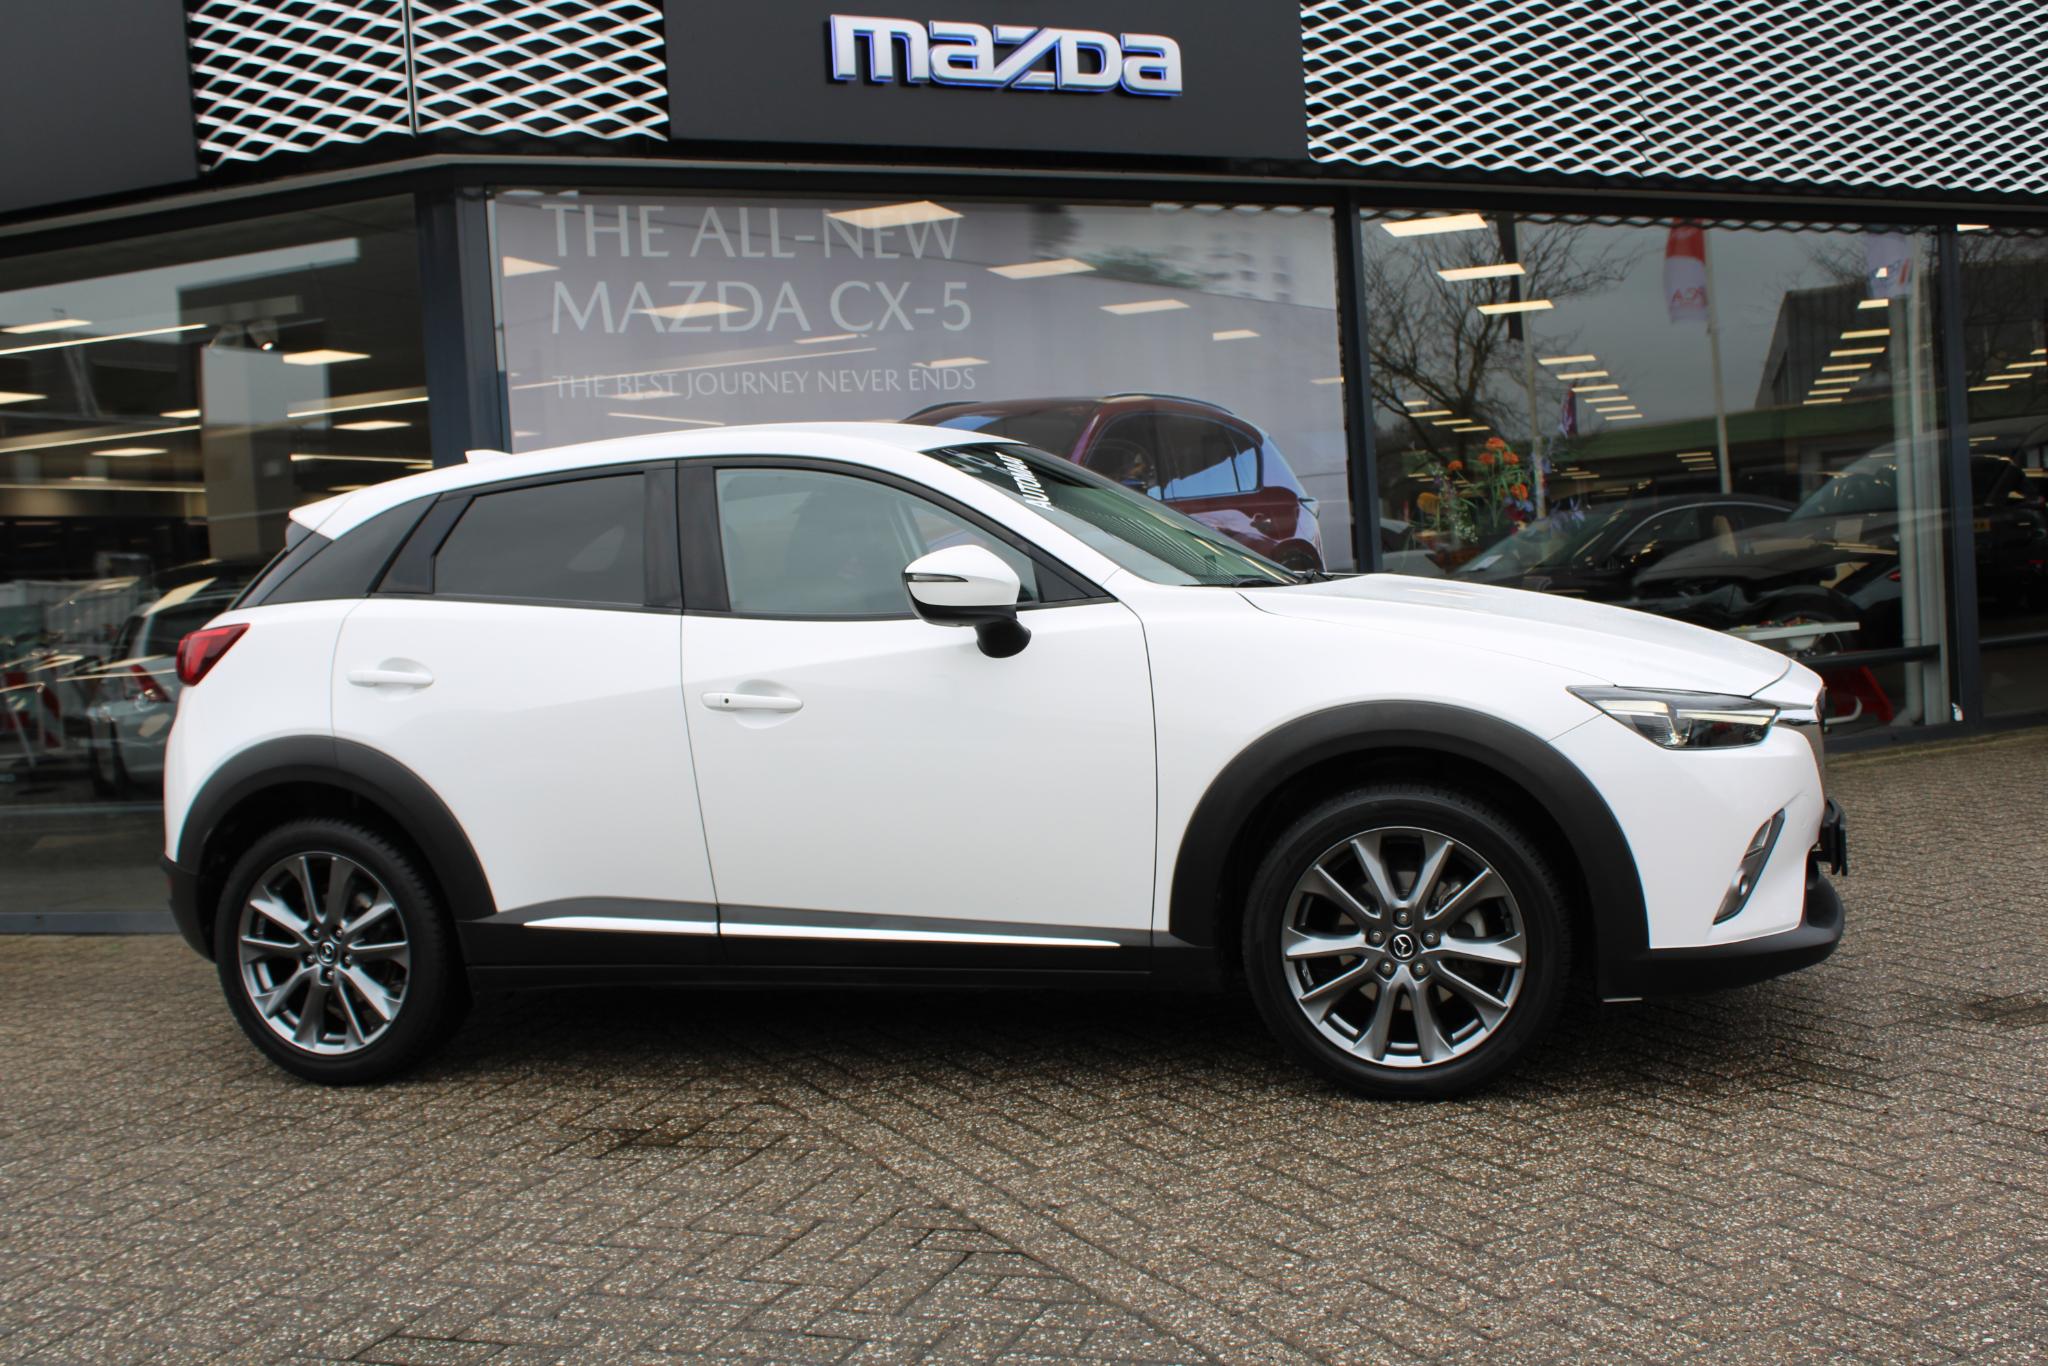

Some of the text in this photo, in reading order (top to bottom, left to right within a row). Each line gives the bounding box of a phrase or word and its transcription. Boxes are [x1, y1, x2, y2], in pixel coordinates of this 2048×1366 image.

[542, 204, 960, 259] THE ALL-NEW
[551, 281, 972, 334] MAZDA CX-5
[552, 366, 976, 399] THE BEST JOURNEY NEVER ENDS
